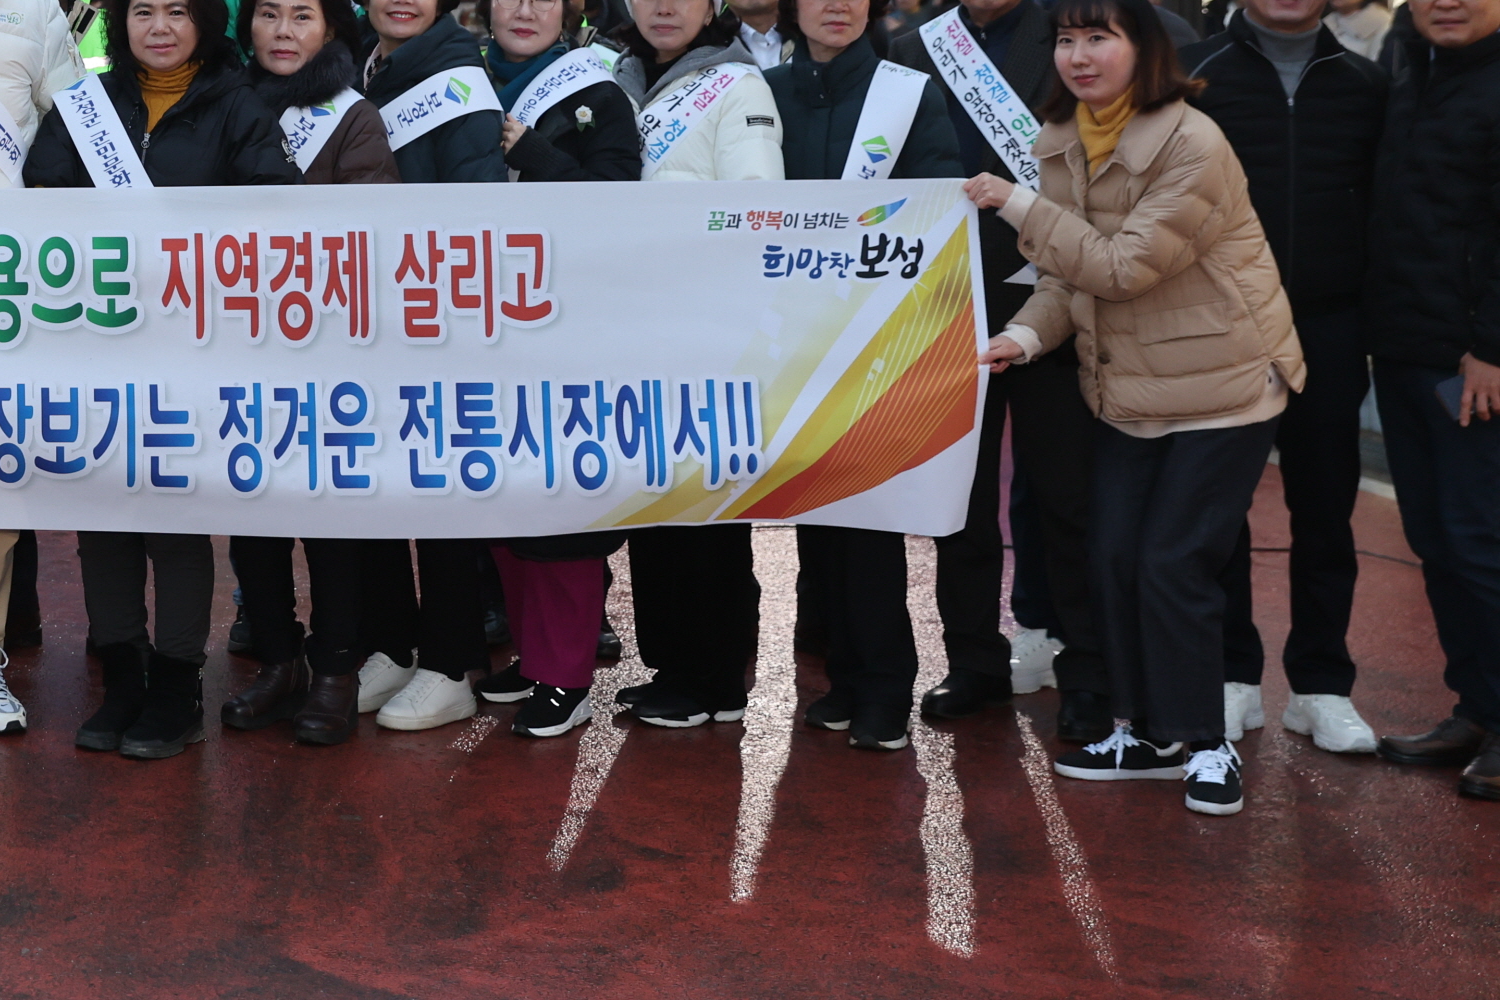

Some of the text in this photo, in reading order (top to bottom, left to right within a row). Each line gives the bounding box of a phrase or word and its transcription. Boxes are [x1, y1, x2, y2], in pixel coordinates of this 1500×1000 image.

[397, 91, 442, 128] 보성군
[662, 68, 718, 112] 우리가
[932, 36, 968, 85] 우리가
[964, 87, 1040, 192] 앞장서겠습
[68, 90, 133, 188] 보성군 군민문화
[707, 210, 850, 231] 꿈과 행복이 넘치는
[762, 232, 924, 279] 희망찬 보성
[162, 232, 370, 341] 지역경제
[396, 231, 553, 338] 살리고
[219, 382, 378, 494] 정겨운
[399, 379, 762, 492] 전통시장에서!!
